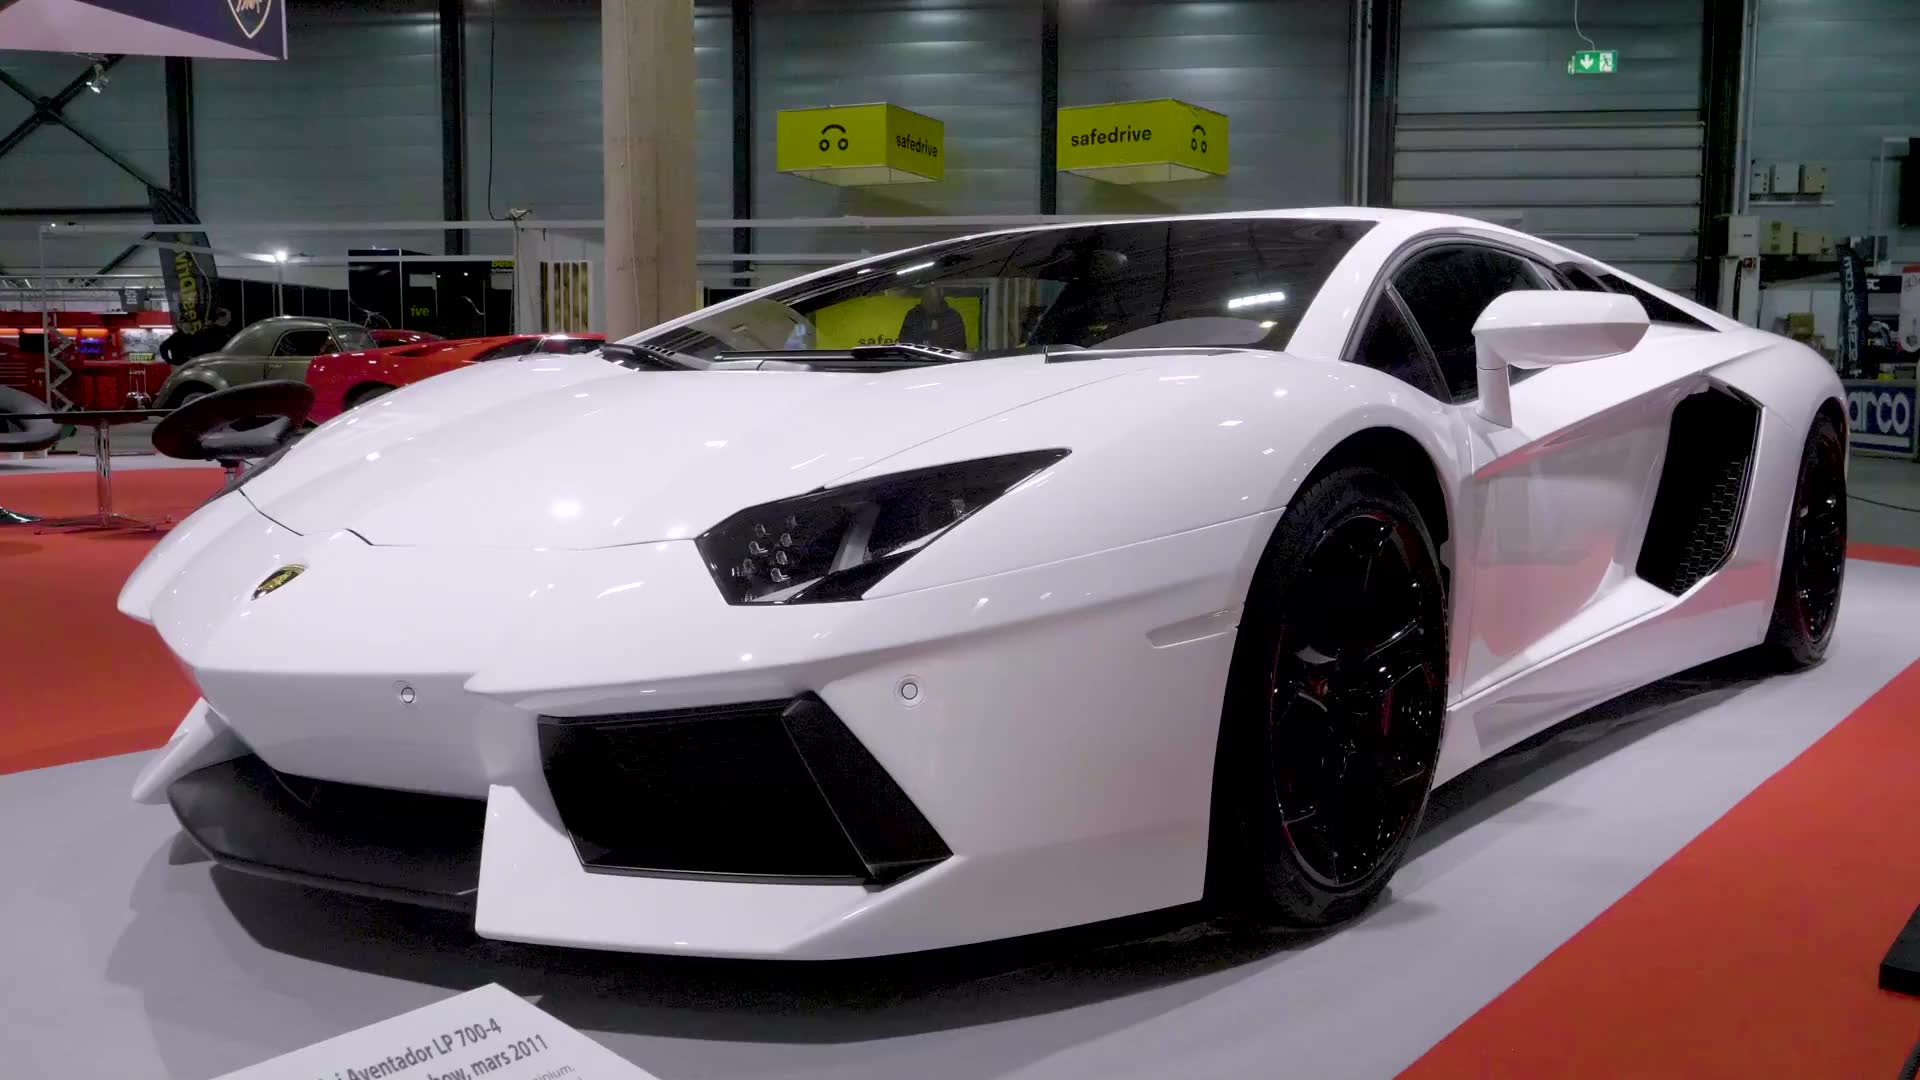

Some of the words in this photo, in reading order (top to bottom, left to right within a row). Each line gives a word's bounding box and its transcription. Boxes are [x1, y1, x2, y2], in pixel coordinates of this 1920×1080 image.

[896, 133, 938, 158] safedrive
[1071, 125, 1152, 147] safedrive
[346, 1046, 434, 1080] Aventador
[432, 1034, 454, 1056] LP
[454, 1018, 502, 1048] 700-4
[470, 1051, 512, 1077] mars
[508, 1034, 549, 1061] 2011
